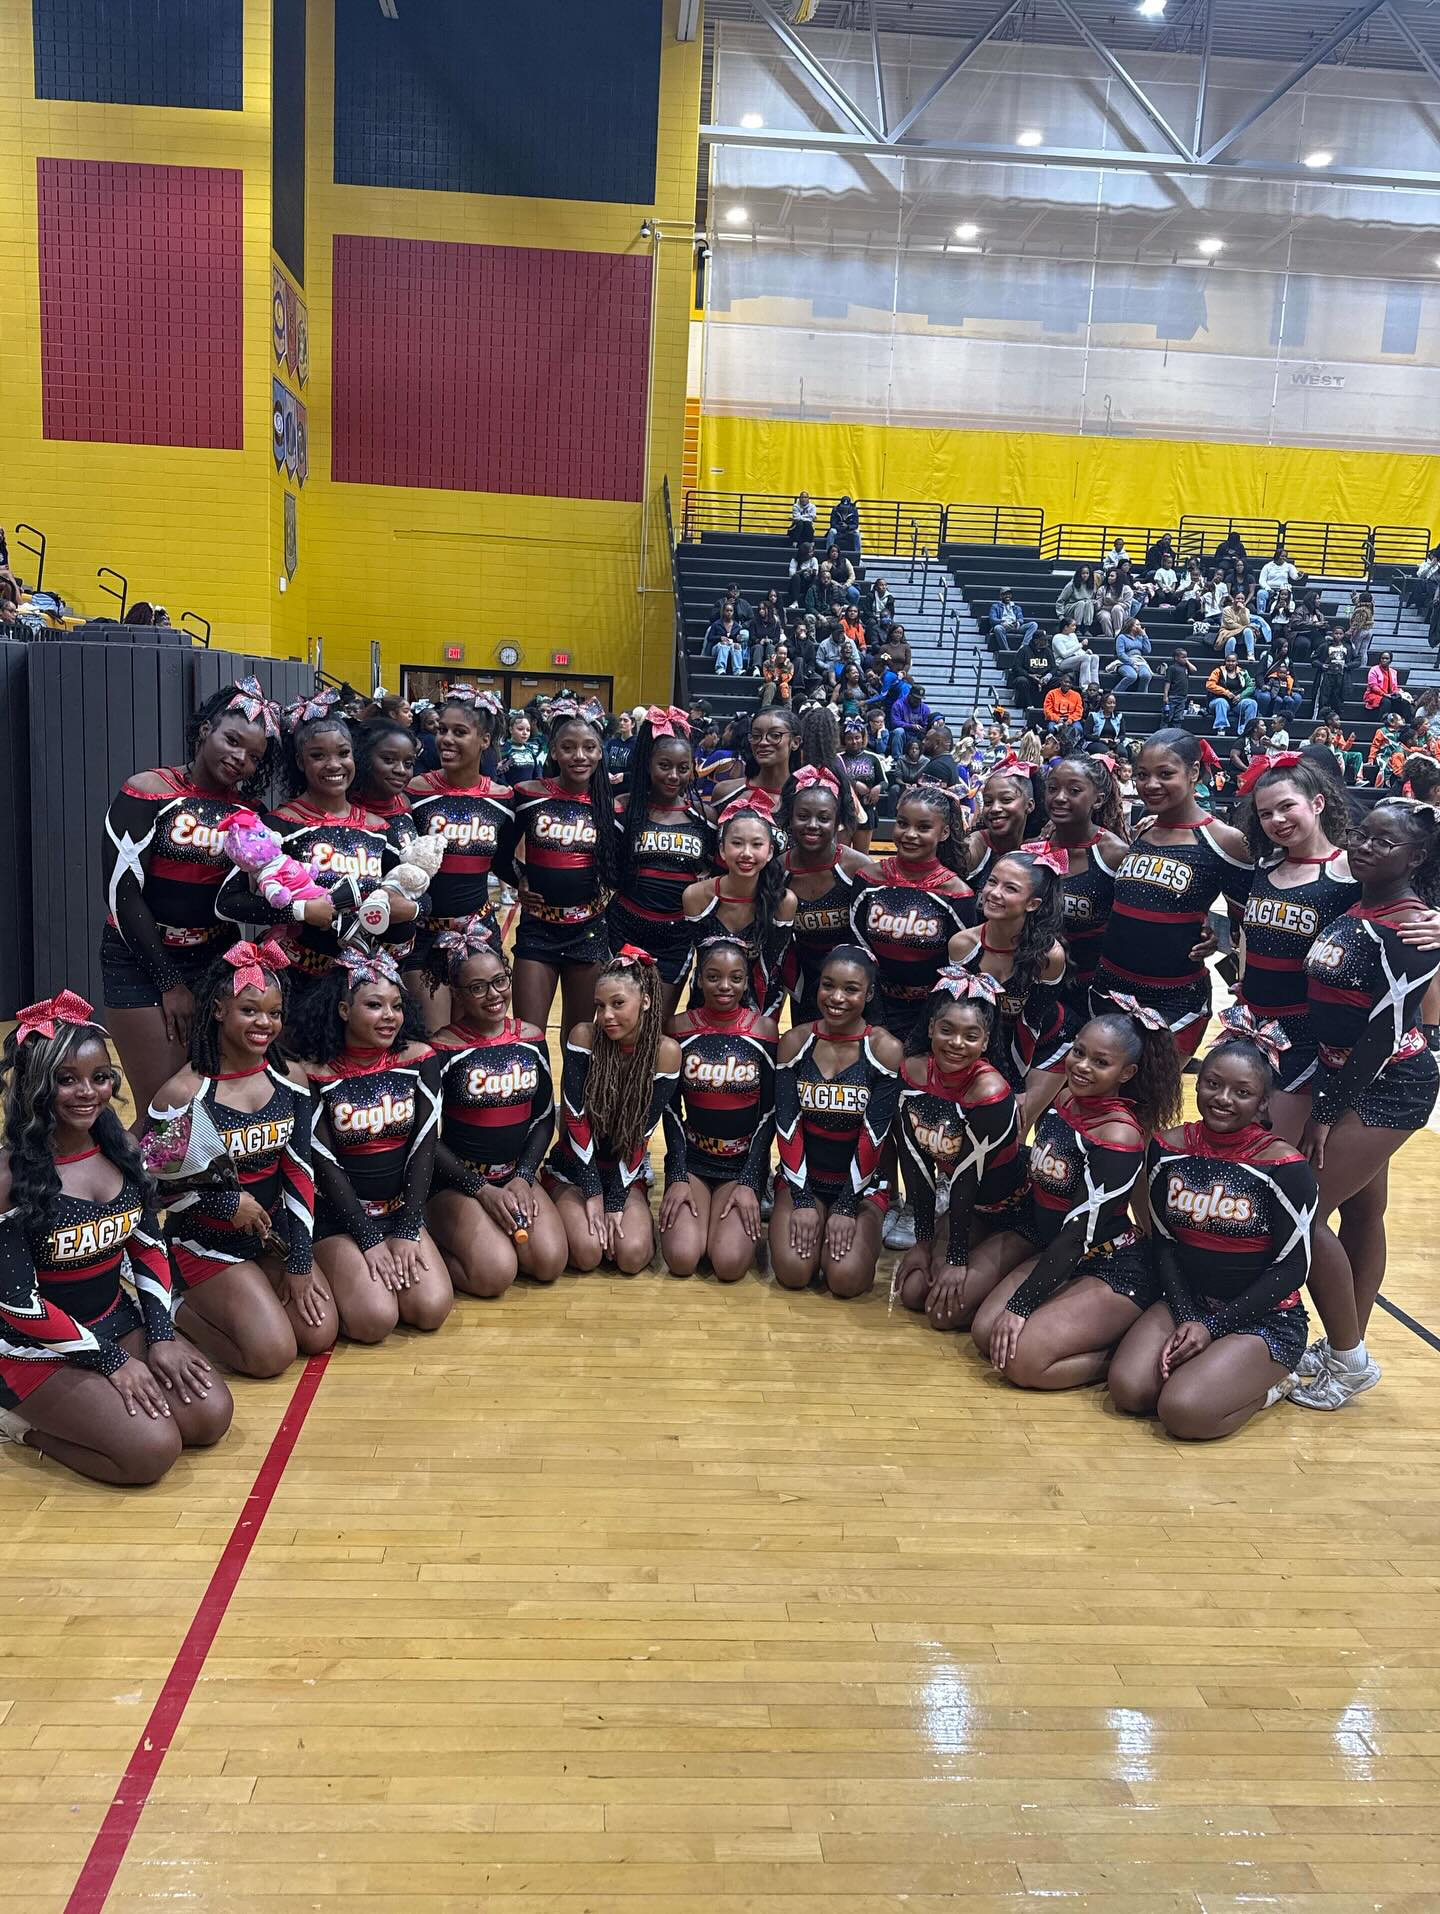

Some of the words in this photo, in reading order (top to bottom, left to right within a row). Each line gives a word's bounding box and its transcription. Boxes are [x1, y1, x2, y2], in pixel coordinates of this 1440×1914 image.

[1290, 374, 1345, 386] WEST
[448, 648, 460, 659] EXIT
[1030, 658, 1048, 667] POLO
[170, 813, 225, 857] Eag
[428, 814, 496, 847] Eagles
[638, 831, 702, 858] AGLES
[1116, 853, 1193, 893] AGLES
[793, 908, 849, 931] AGLES
[868, 903, 938, 939] Eagles
[1244, 896, 1319, 937] AGLES
[468, 1062, 538, 1099] Eagles
[683, 1054, 756, 1087] Eagles
[333, 1093, 414, 1135] Eagles
[222, 1116, 294, 1161] AGLES
[1030, 1142, 1068, 1180] gles
[1166, 1175, 1252, 1222] Eagles
[52, 1205, 143, 1262] EAGLE
